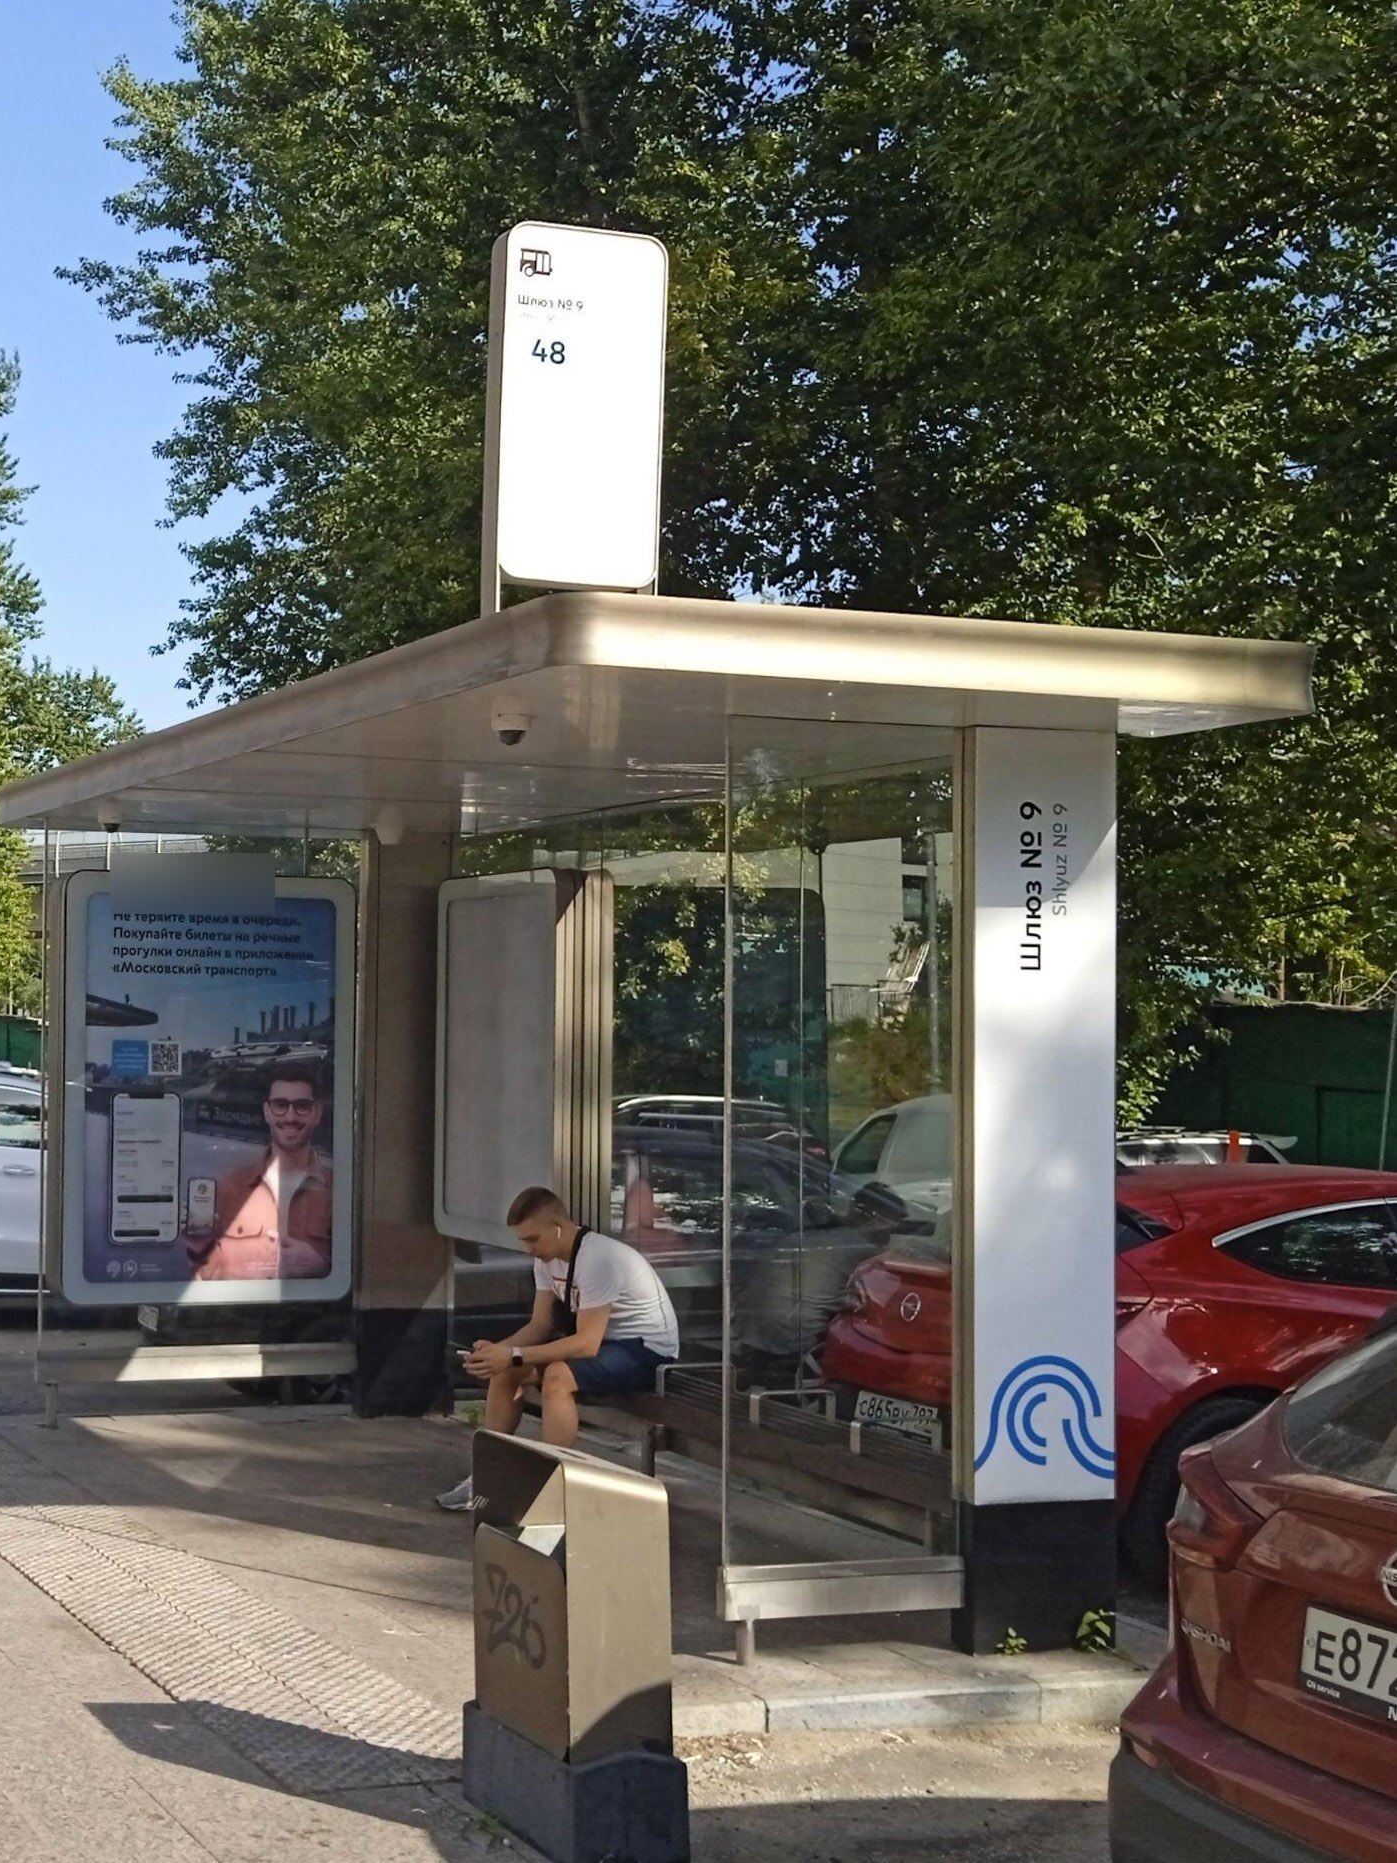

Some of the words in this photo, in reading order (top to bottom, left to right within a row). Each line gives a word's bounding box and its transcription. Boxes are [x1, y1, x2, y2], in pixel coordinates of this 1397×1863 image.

[517, 294, 554, 309] Шлюз
[557, 299, 573, 311] №
[576, 300, 584, 311] 9
[531, 338, 566, 365] 48
[1019, 801, 1042, 820] 9
[1052, 803, 1068, 815] 9
[1052, 823, 1068, 847] №
[1019, 830, 1042, 868] №
[1052, 854, 1070, 916] Shlyuz
[189, 914, 229, 926] время
[232, 916, 239, 924] в
[1020, 880, 1042, 971] Шлюз
[113, 927, 182, 942] Покупайте
[185, 928, 231, 942] билеты
[235, 932, 250, 942] на
[252, 933, 301, 944] речные
[112, 946, 173, 958] прогулки
[175, 947, 221, 958] онлайн
[224, 949, 232, 958] в
[235, 949, 314, 961] приложении
[113, 961, 202, 975] «Московский
[204, 965, 277, 979] транспорт»
[1316, 1684, 1341, 1699] service
